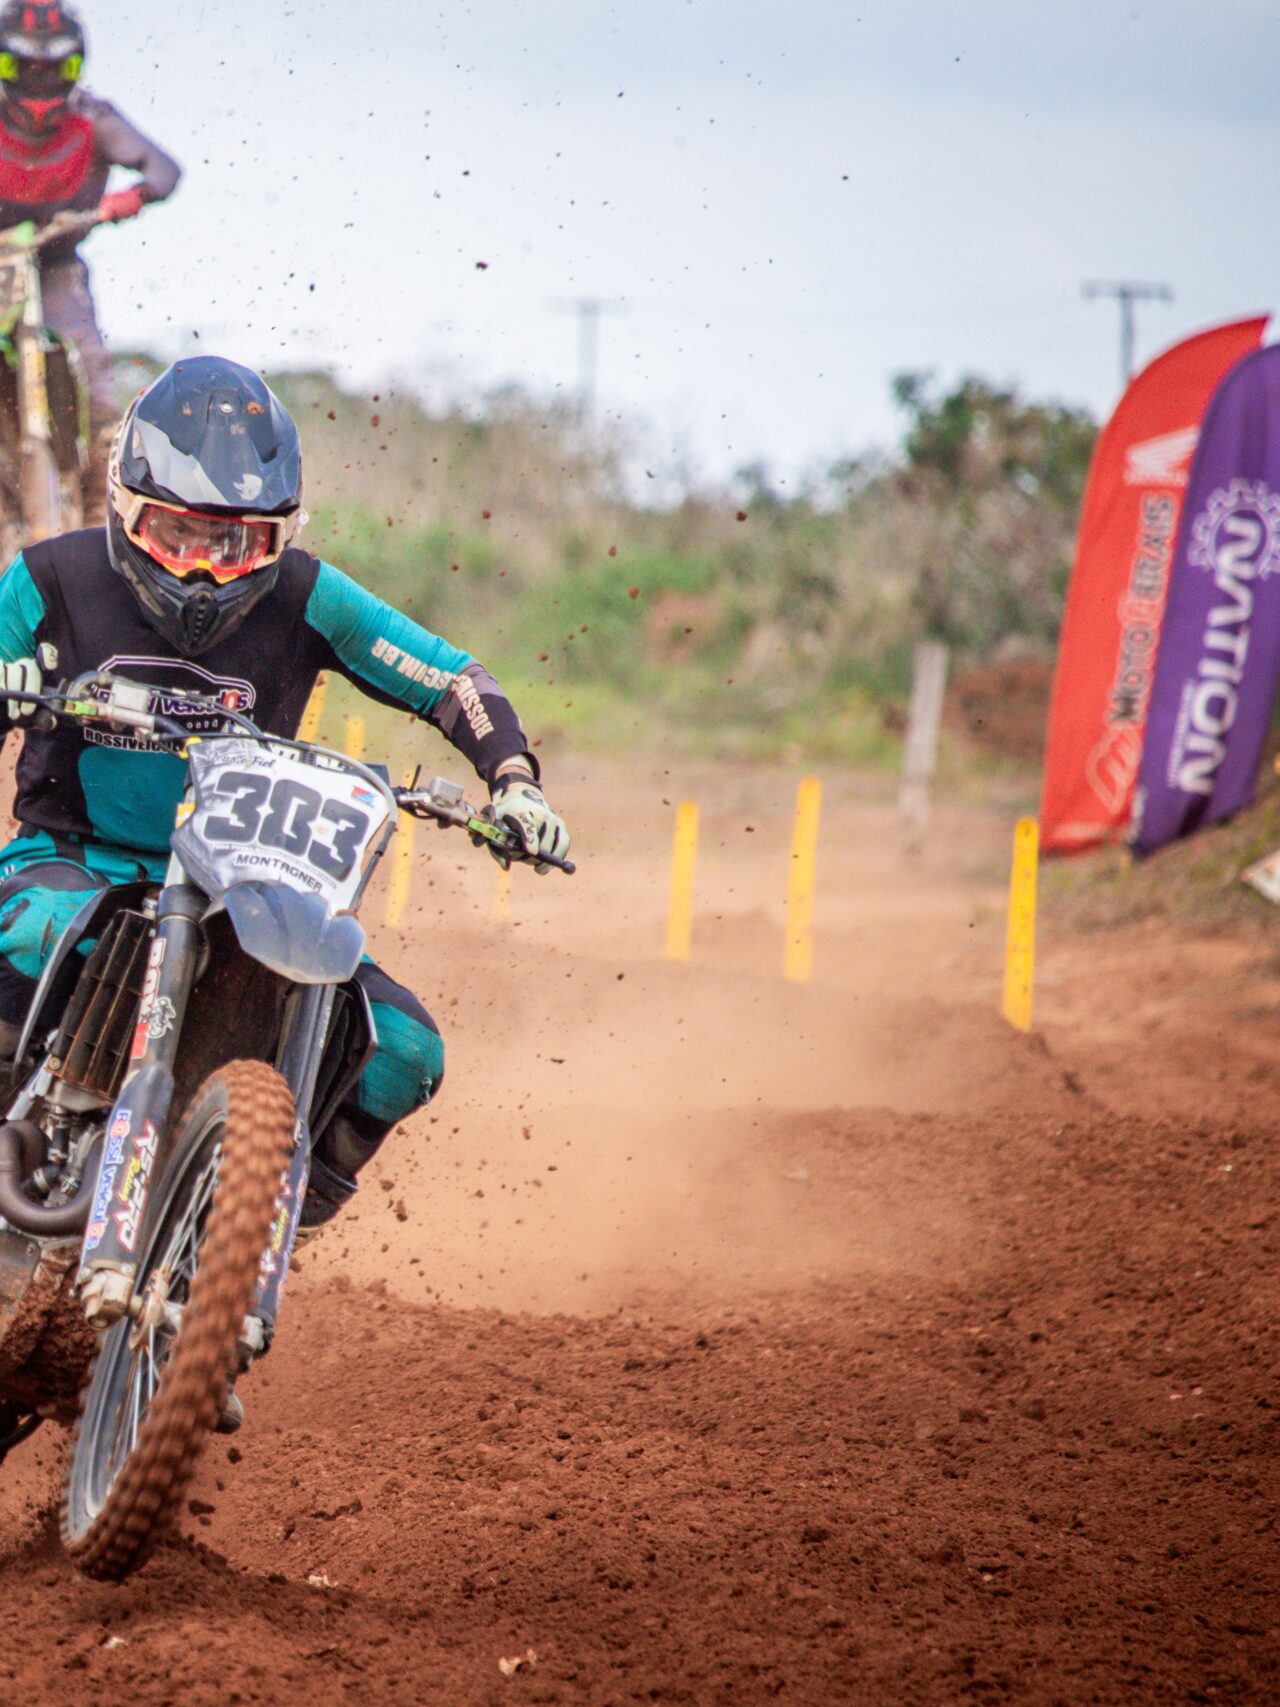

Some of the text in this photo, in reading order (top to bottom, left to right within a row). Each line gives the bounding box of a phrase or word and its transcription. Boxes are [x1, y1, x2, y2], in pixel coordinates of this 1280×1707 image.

[1179, 514, 1262, 794] NATION
[251, 755, 277, 769] Fiel
[202, 771, 371, 884] 303
[235, 854, 324, 892] MONTAGNER
